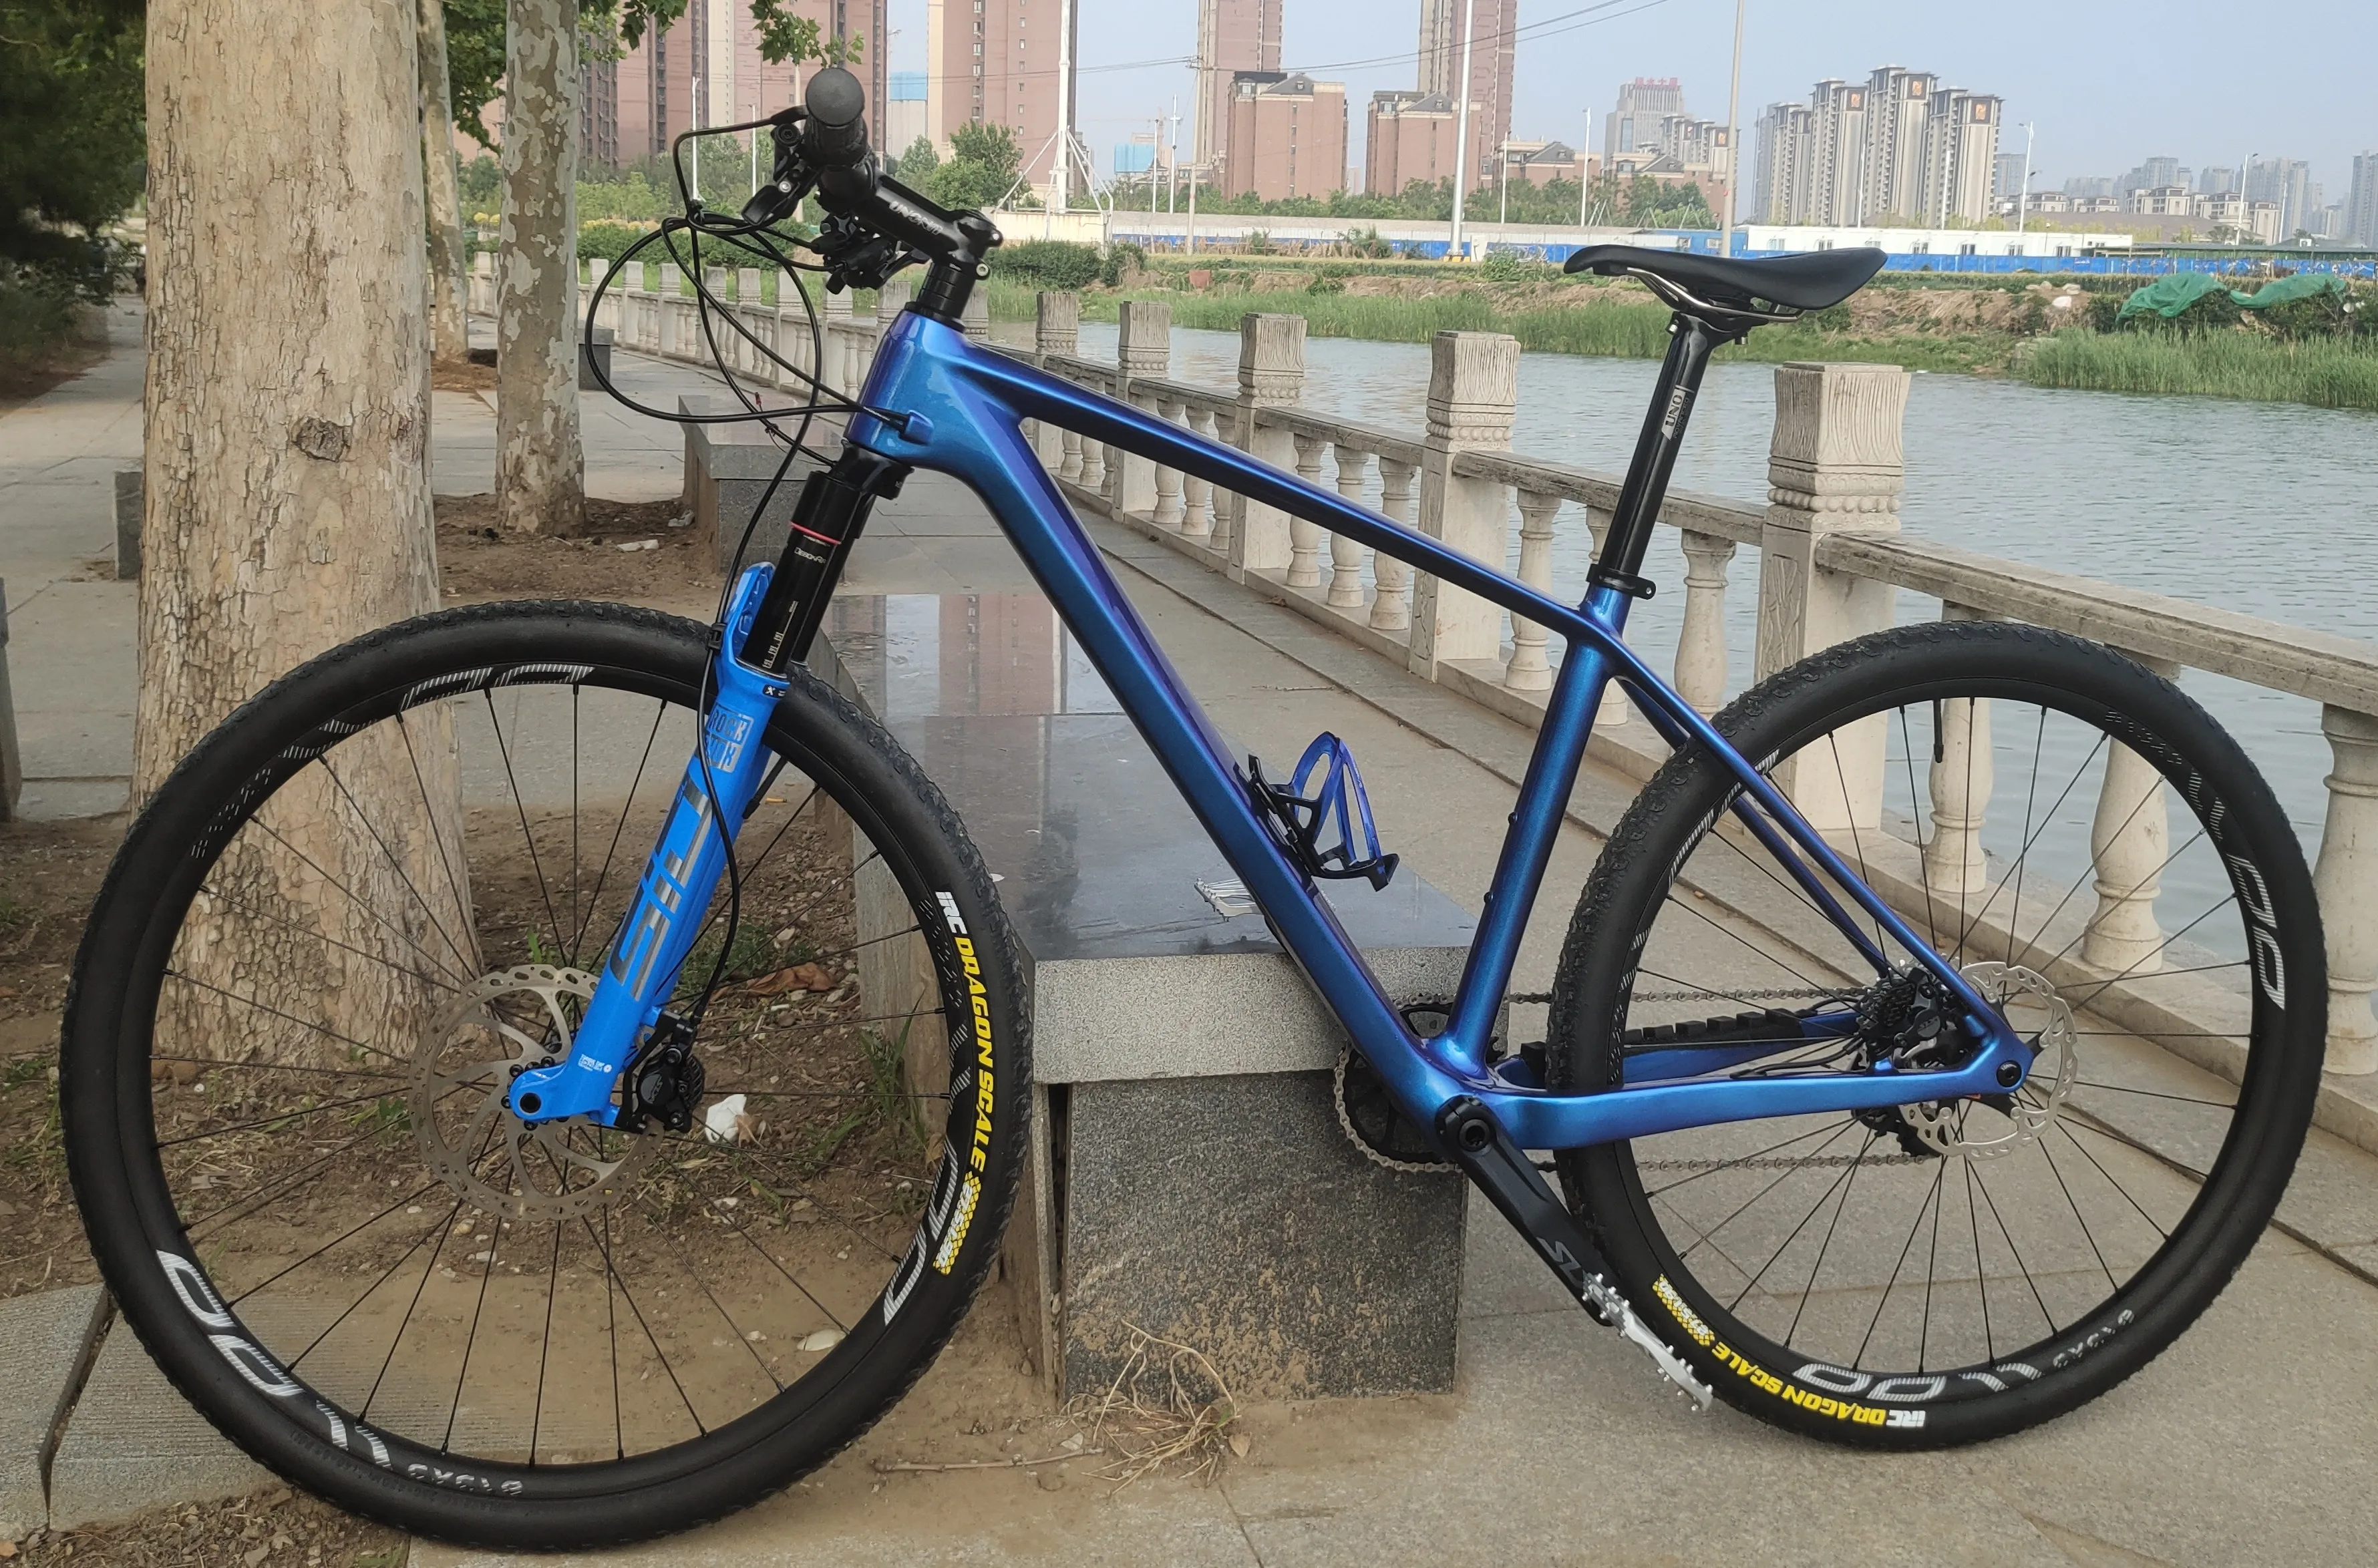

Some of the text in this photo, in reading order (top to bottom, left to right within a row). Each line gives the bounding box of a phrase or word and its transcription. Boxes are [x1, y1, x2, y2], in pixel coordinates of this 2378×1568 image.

[1665, 394, 1683, 427] UNO
[708, 708, 748, 742] ROCK
[954, 936, 994, 1068] DRAGON
[969, 1070, 995, 1173] SCALE
[1710, 1340, 1784, 1396] SCALE
[1781, 1384, 1887, 1426] DRAGON
